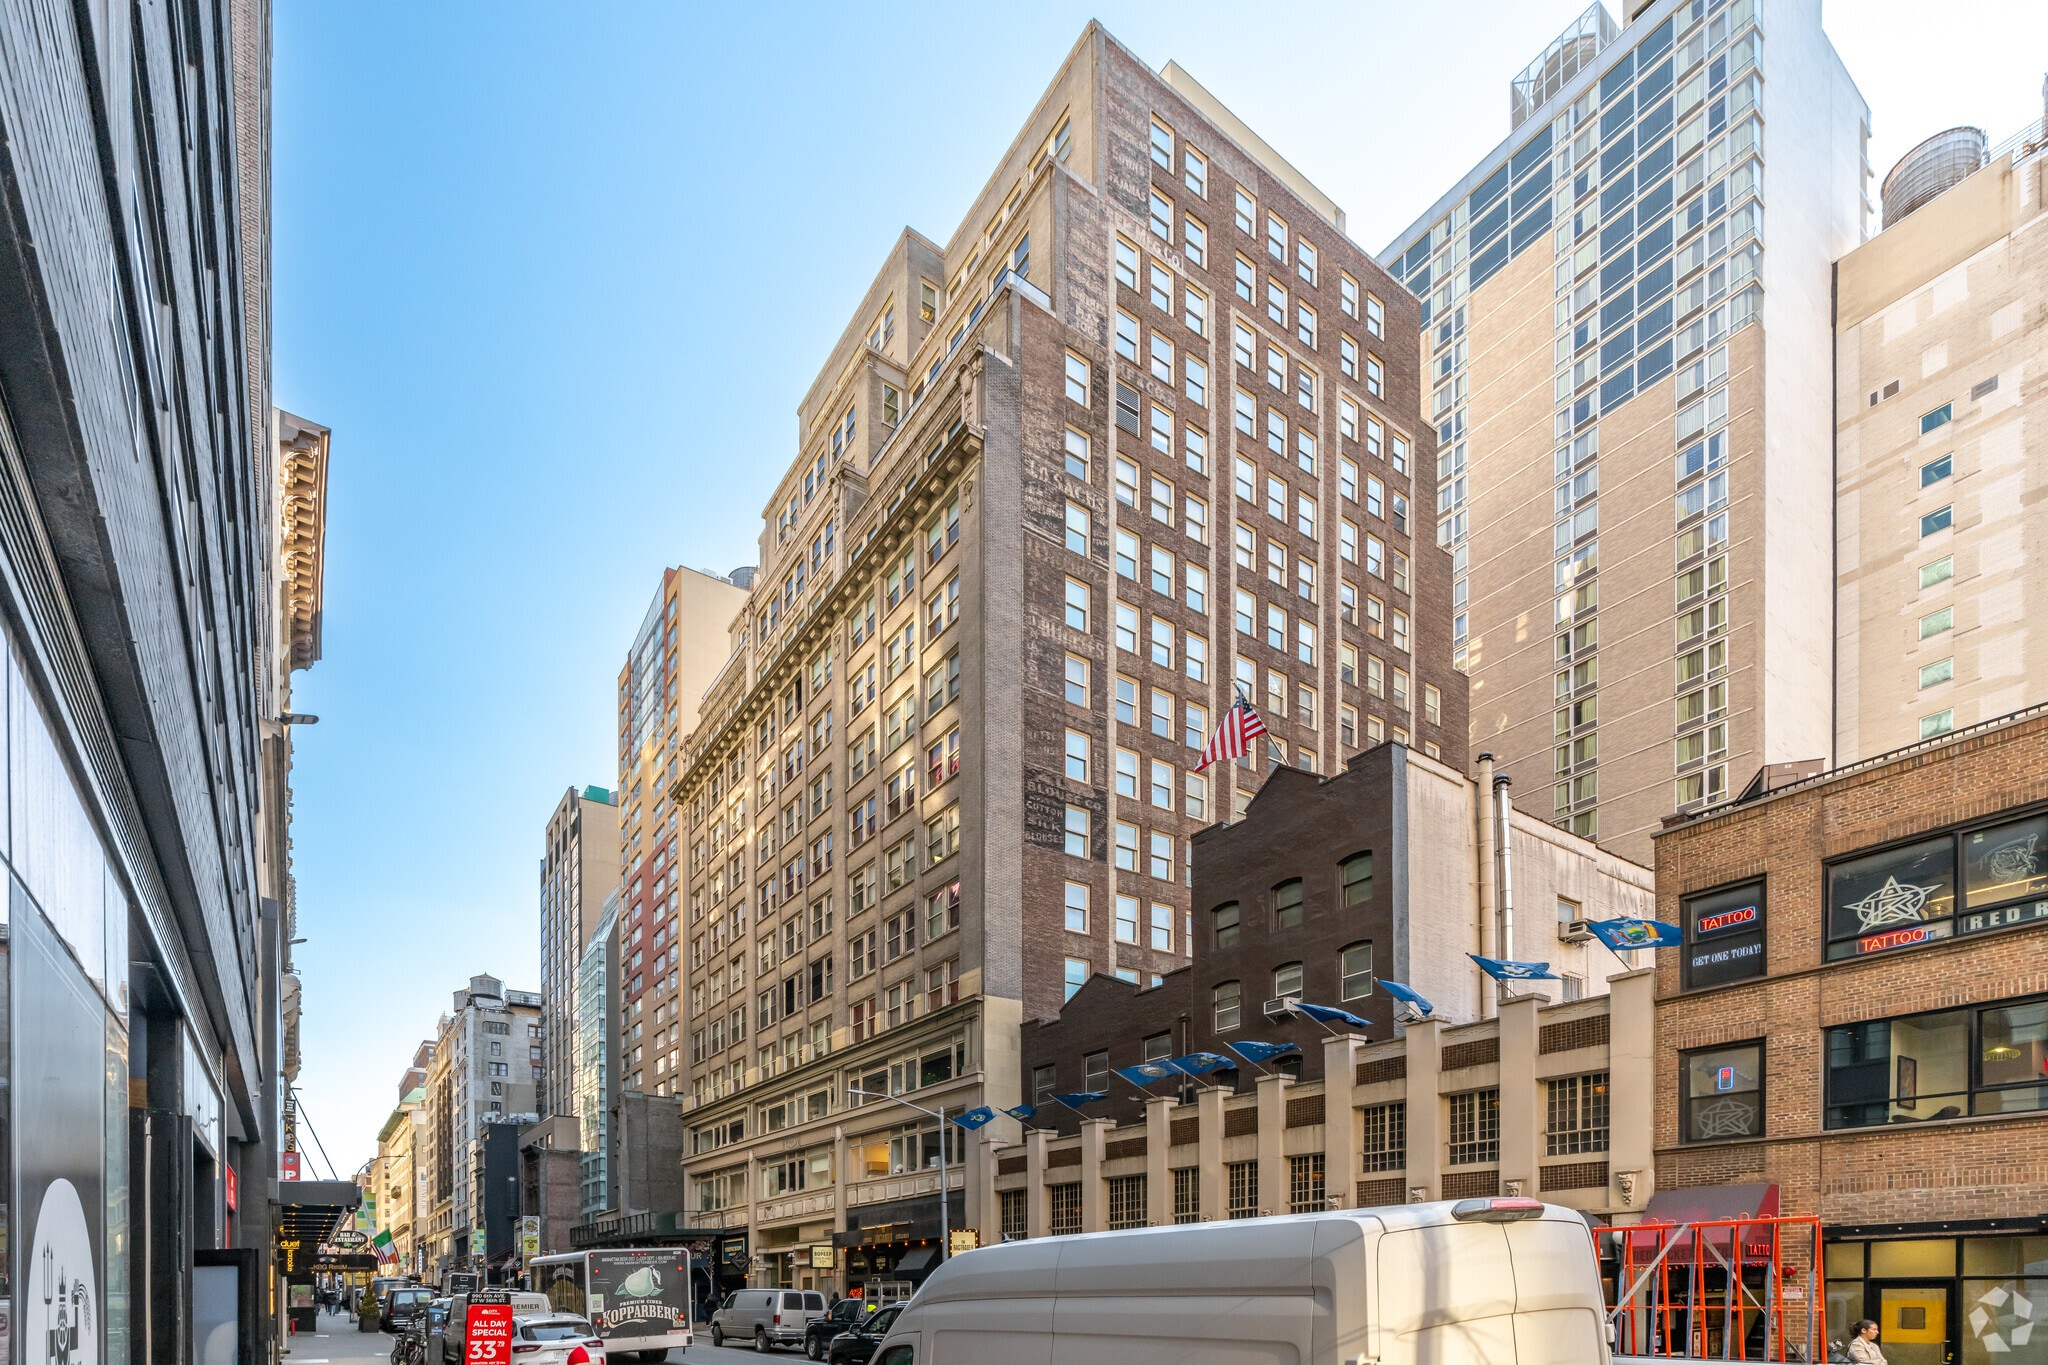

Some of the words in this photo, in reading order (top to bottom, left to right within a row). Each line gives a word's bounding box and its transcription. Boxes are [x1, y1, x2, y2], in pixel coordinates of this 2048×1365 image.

[1702, 908, 1754, 930] TATTOO
[1969, 908, 2020, 930] RED
[1861, 928, 1924, 952] TATTOO
[1692, 954, 1710, 967] GET
[1711, 950, 1729, 963] ONE
[1730, 943, 1762, 959] TODAY!
[280, 1239, 300, 1248] duet
[1748, 1244, 1770, 1256] TATTO
[434, 1314, 441, 1322] P
[472, 1329, 507, 1337] SPECIAL
[469, 1340, 497, 1360] 33
